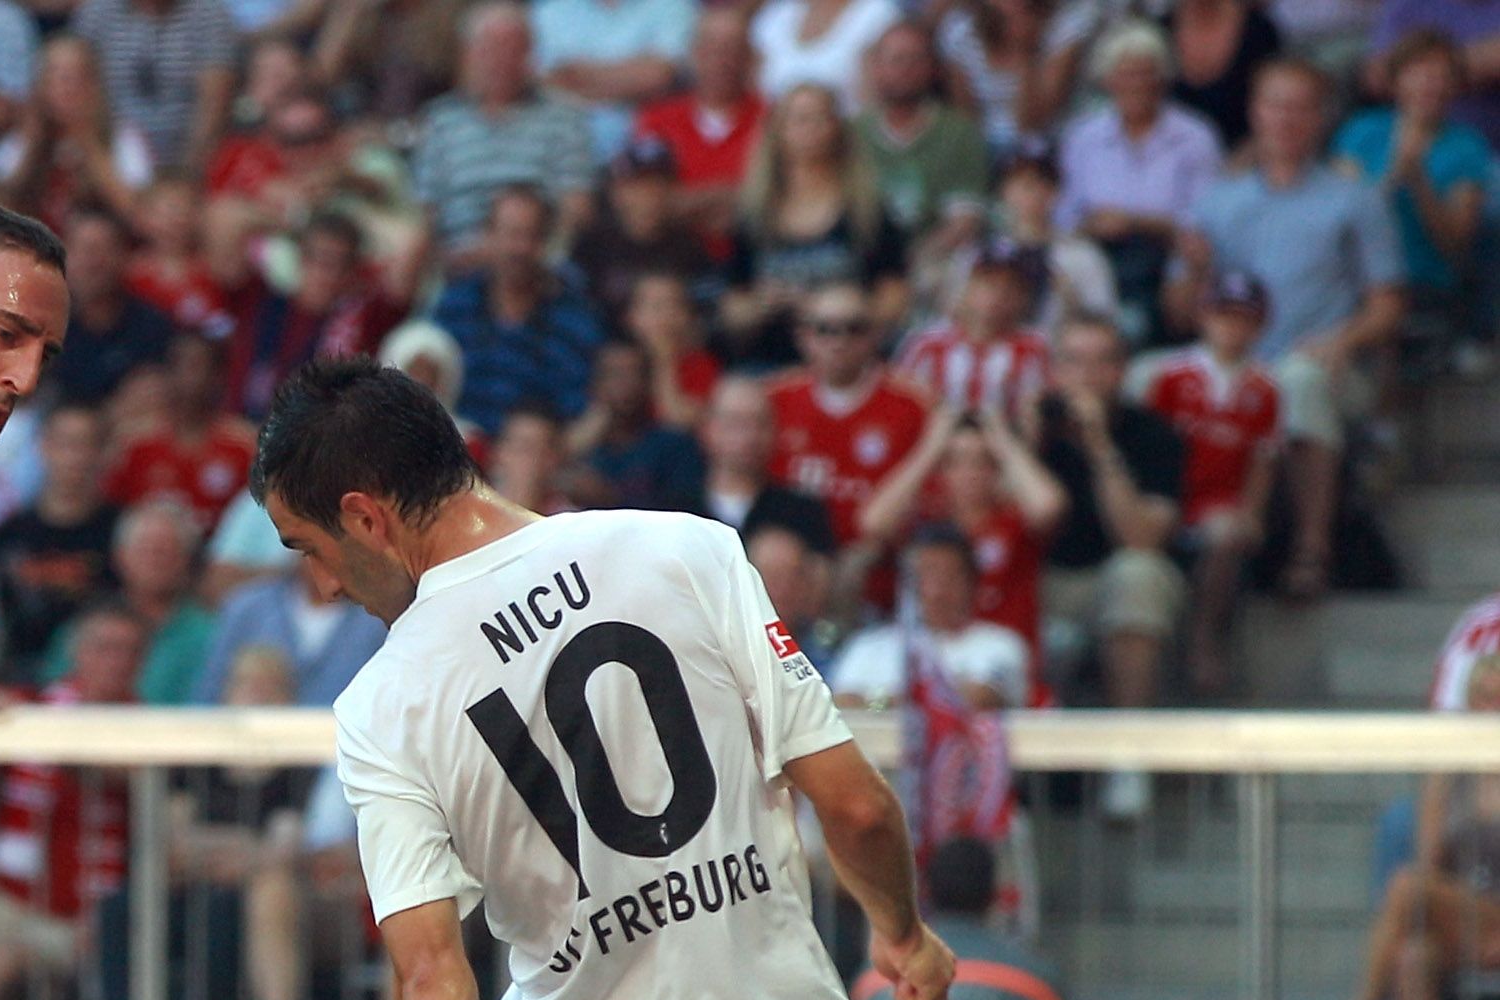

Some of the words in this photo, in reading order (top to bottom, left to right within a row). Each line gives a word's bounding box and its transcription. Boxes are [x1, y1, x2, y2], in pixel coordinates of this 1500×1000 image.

[480, 561, 591, 664] NICU
[465, 620, 718, 902] 10
[589, 844, 771, 955] FREBURG
